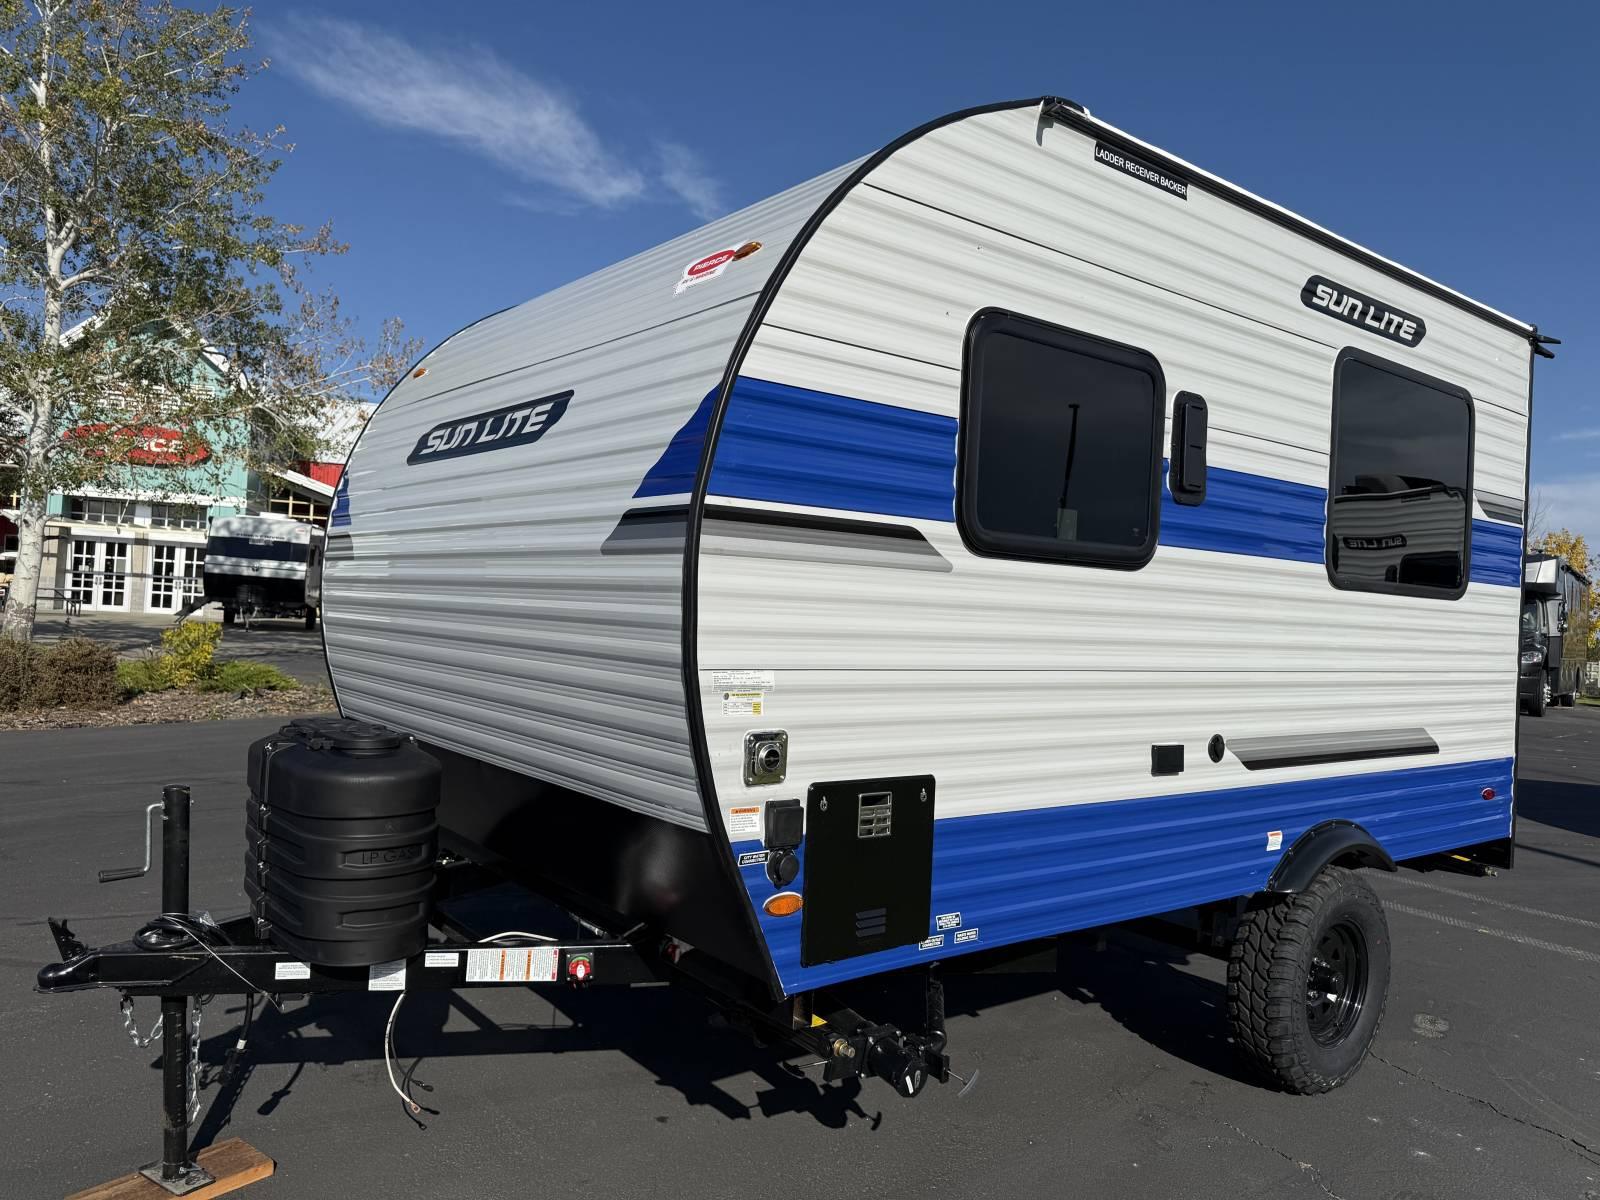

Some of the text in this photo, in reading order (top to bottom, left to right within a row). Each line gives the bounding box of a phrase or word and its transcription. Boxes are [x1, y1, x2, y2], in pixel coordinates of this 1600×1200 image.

[1095, 146, 1187, 196] LADDER RECEIVER BACKER
[1311, 284, 1417, 341] SUN LITE
[418, 402, 554, 455] SUN LITE
[362, 850, 379, 865] LP
